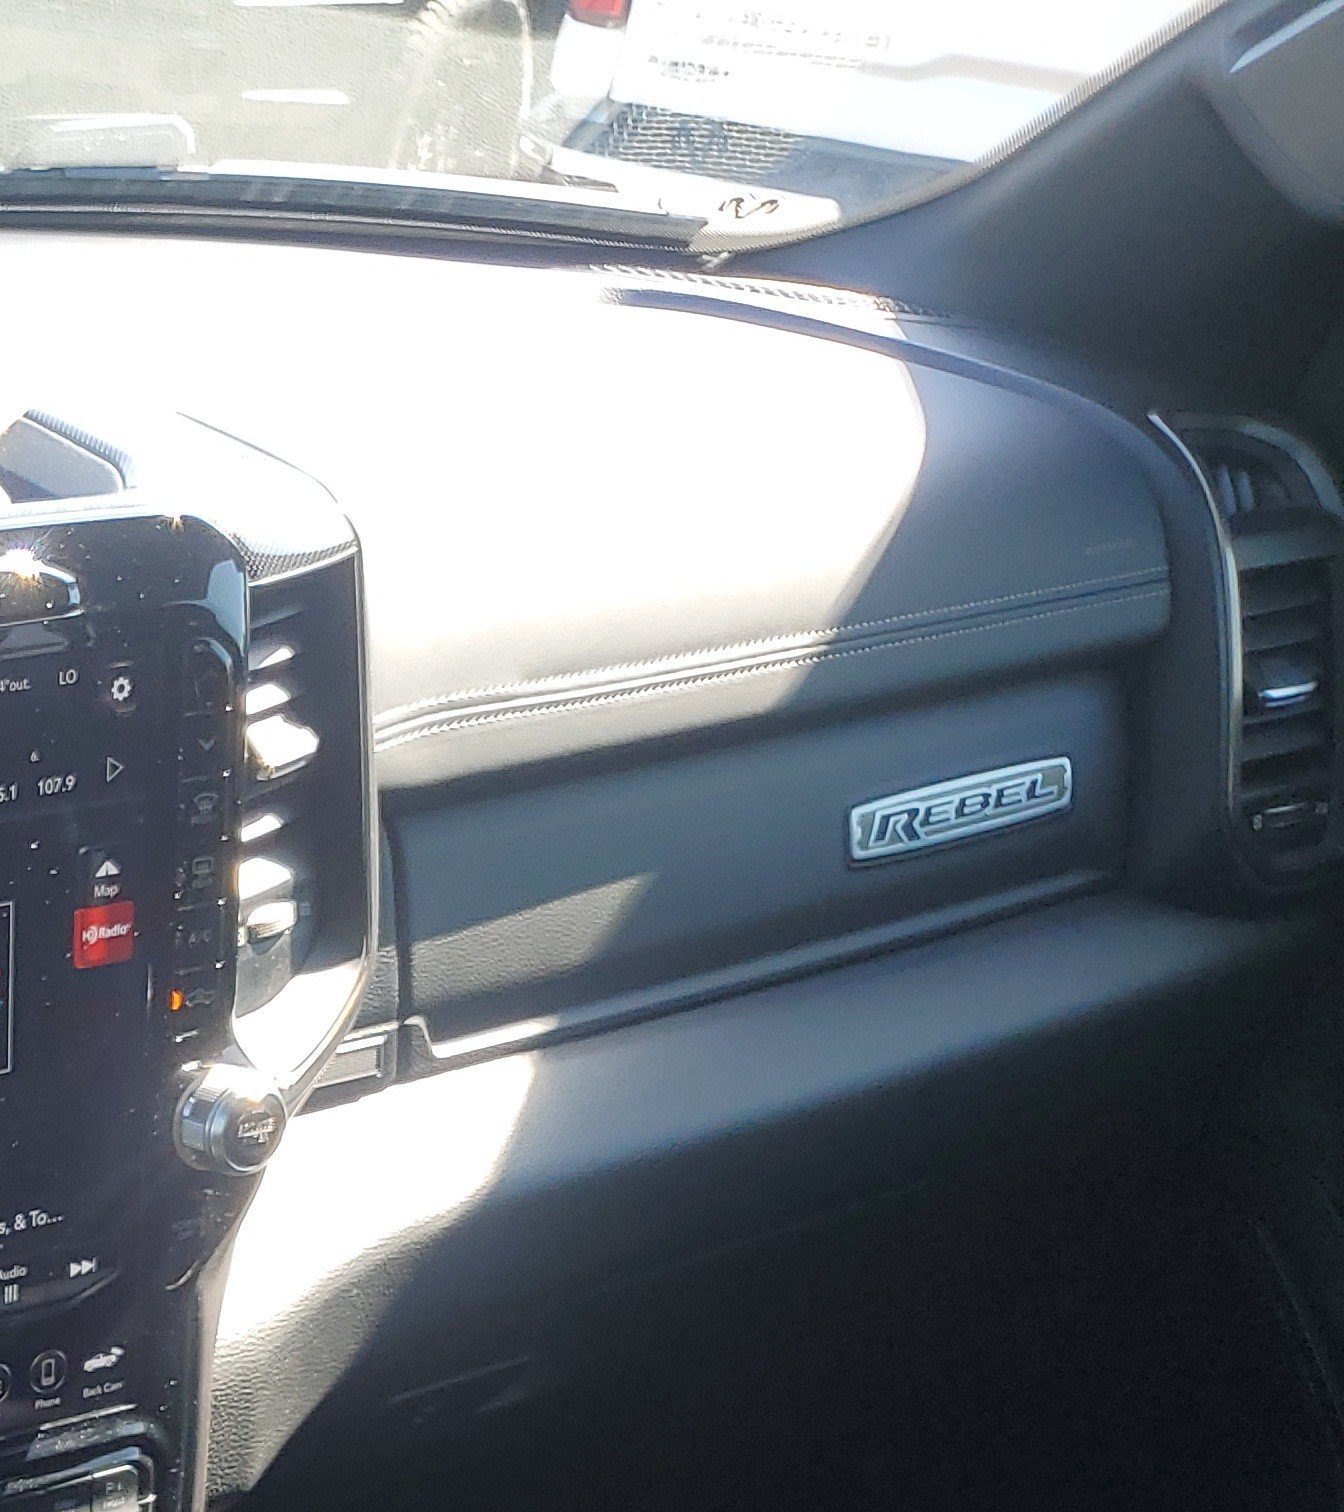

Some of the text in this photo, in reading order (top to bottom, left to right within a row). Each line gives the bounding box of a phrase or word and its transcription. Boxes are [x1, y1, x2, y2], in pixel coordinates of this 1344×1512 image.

[58, 669, 78, 687] LO
[37, 775, 77, 797] 107.9
[869, 772, 1058, 848] REBEL
[93, 882, 120, 899] Map
[14, 1213, 28, 1231] &
